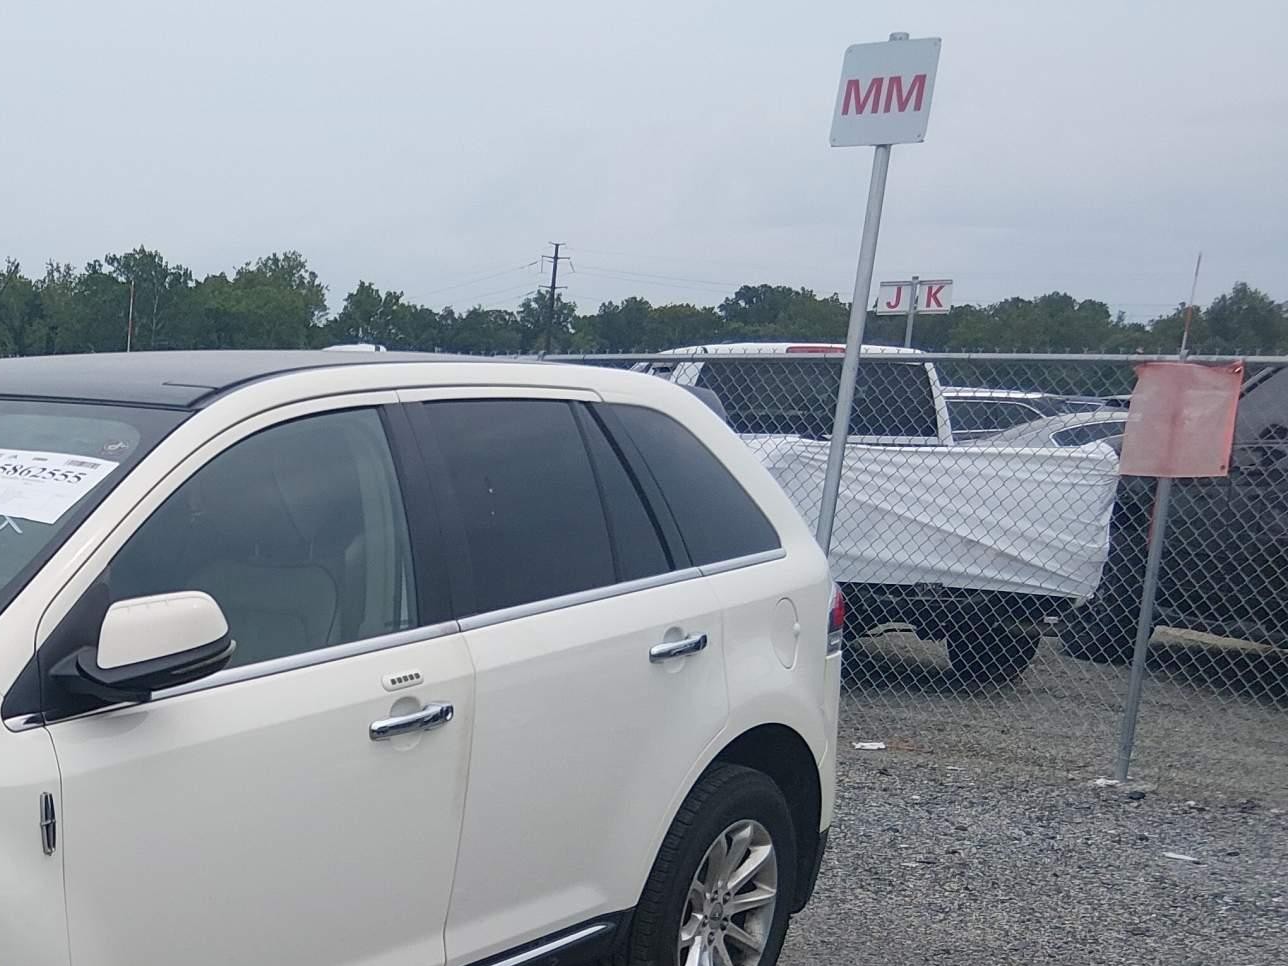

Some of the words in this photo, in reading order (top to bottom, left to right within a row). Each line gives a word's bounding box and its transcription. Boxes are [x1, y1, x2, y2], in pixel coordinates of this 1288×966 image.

[841, 73, 927, 116] MM
[885, 286, 902, 310] J
[925, 285, 945, 309] K
